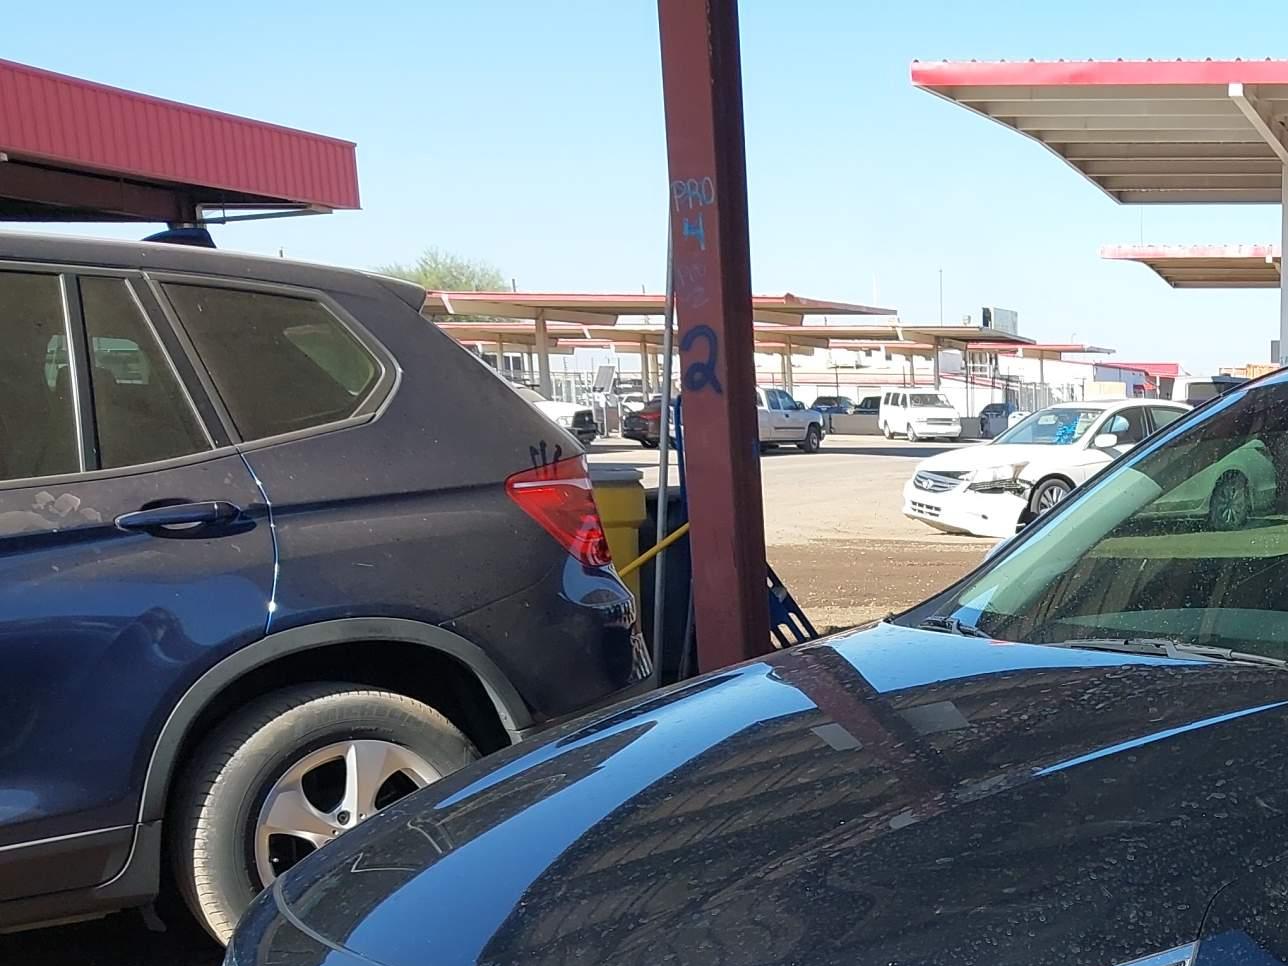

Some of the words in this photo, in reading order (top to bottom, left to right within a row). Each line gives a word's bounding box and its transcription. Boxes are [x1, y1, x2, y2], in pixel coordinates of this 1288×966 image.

[670, 176, 715, 212] PRO
[682, 211, 705, 251] 4
[680, 324, 722, 396] 2
